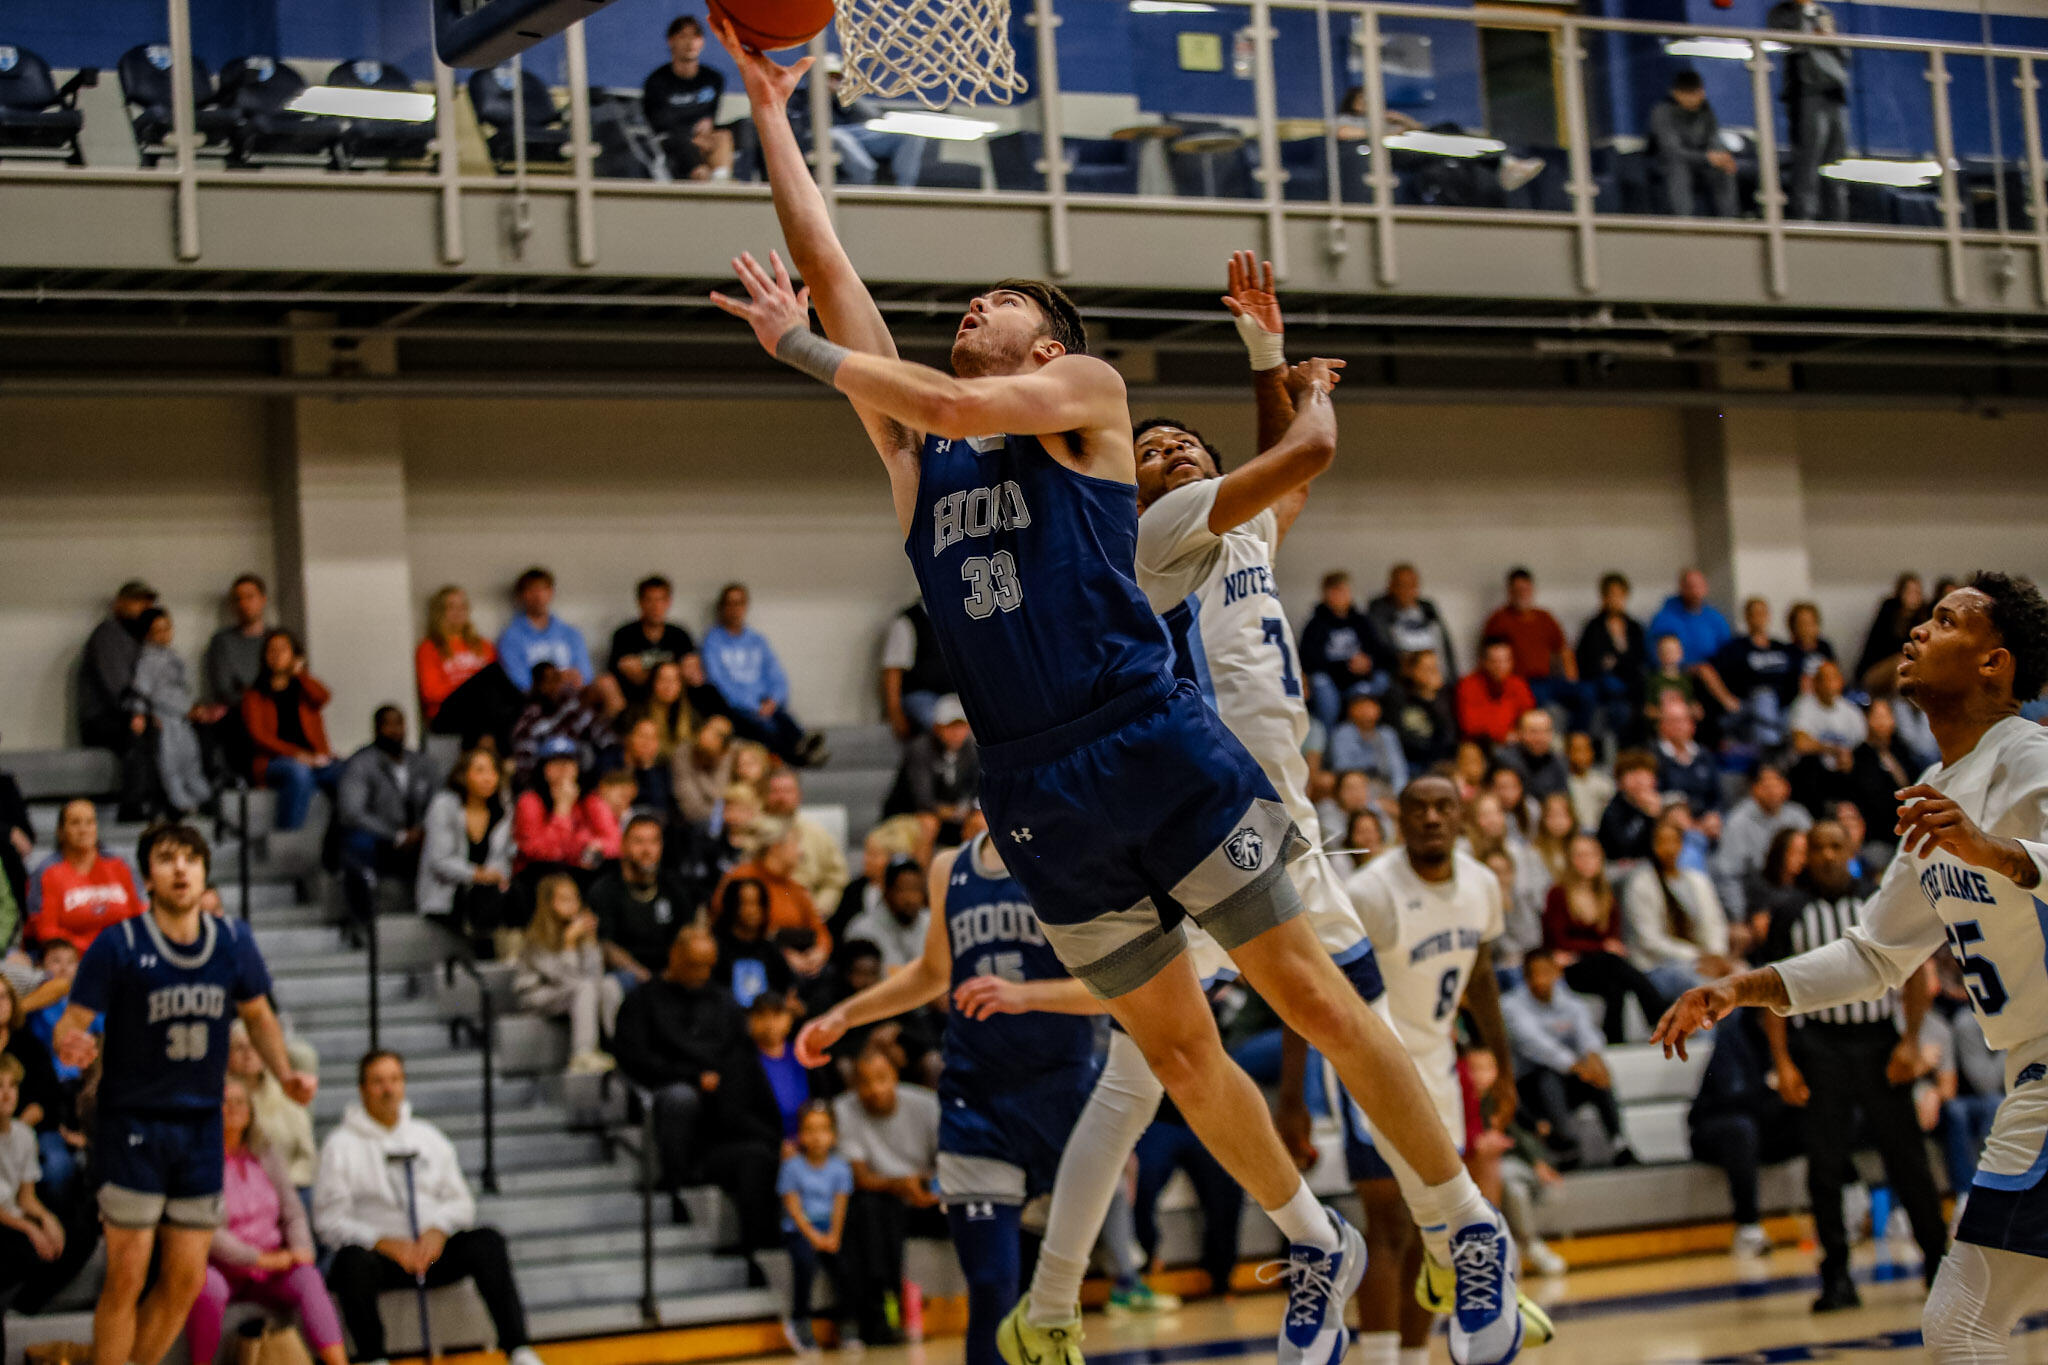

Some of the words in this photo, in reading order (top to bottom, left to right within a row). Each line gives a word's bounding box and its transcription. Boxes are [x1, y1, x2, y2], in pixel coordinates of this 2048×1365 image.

[934, 480, 1032, 558] HOOD
[961, 550, 1023, 620] 33
[1261, 617, 1300, 697] 7
[1938, 863, 1998, 906] DAME
[951, 903, 1046, 960] HOOD
[147, 984, 226, 1025] HOOD
